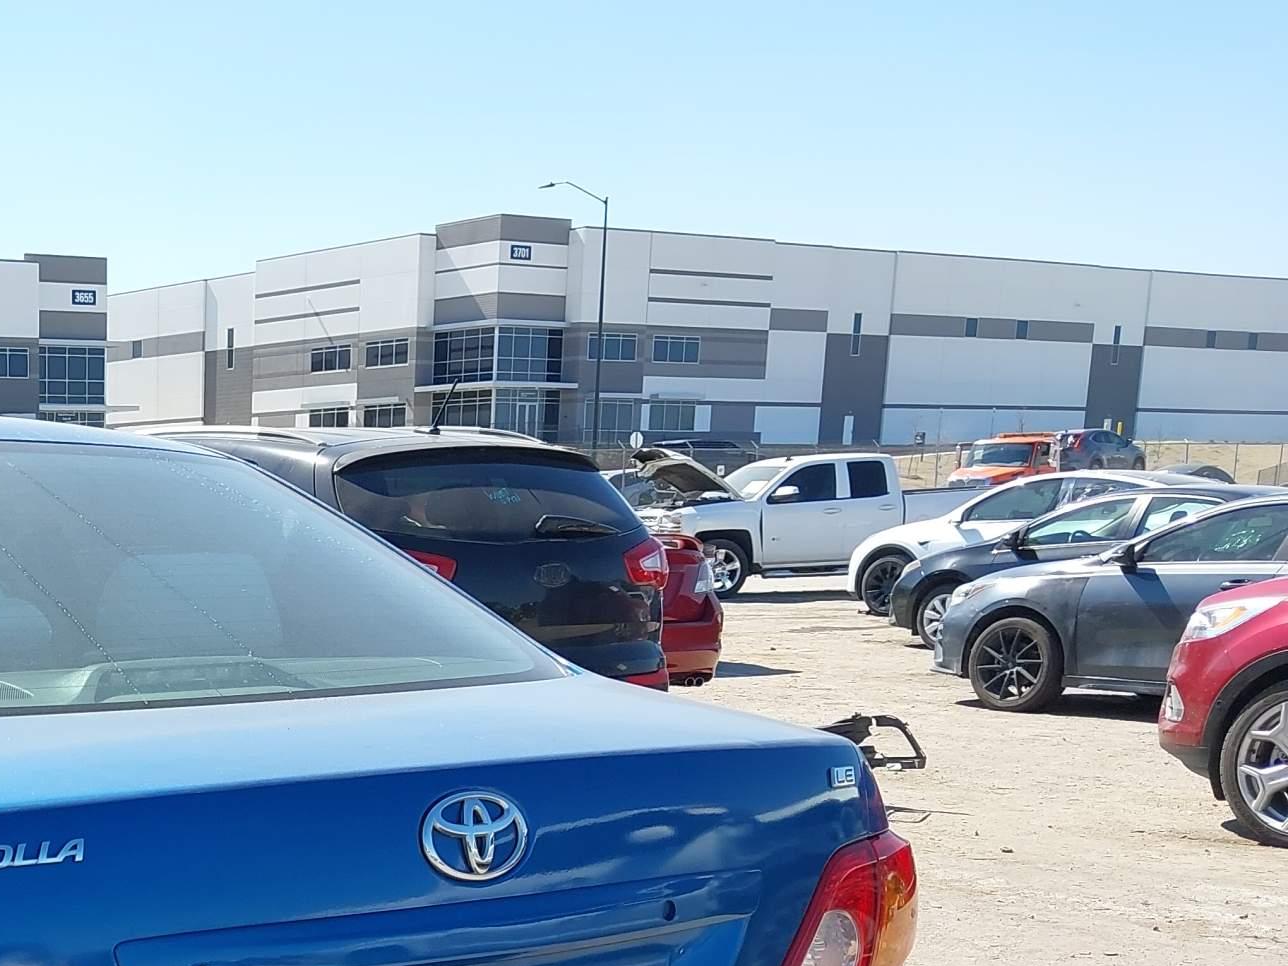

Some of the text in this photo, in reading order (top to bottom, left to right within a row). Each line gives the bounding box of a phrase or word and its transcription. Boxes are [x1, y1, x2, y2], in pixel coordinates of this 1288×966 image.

[512, 247, 529, 259] 3701
[74, 292, 94, 304] 3655
[835, 768, 854, 784] LE
